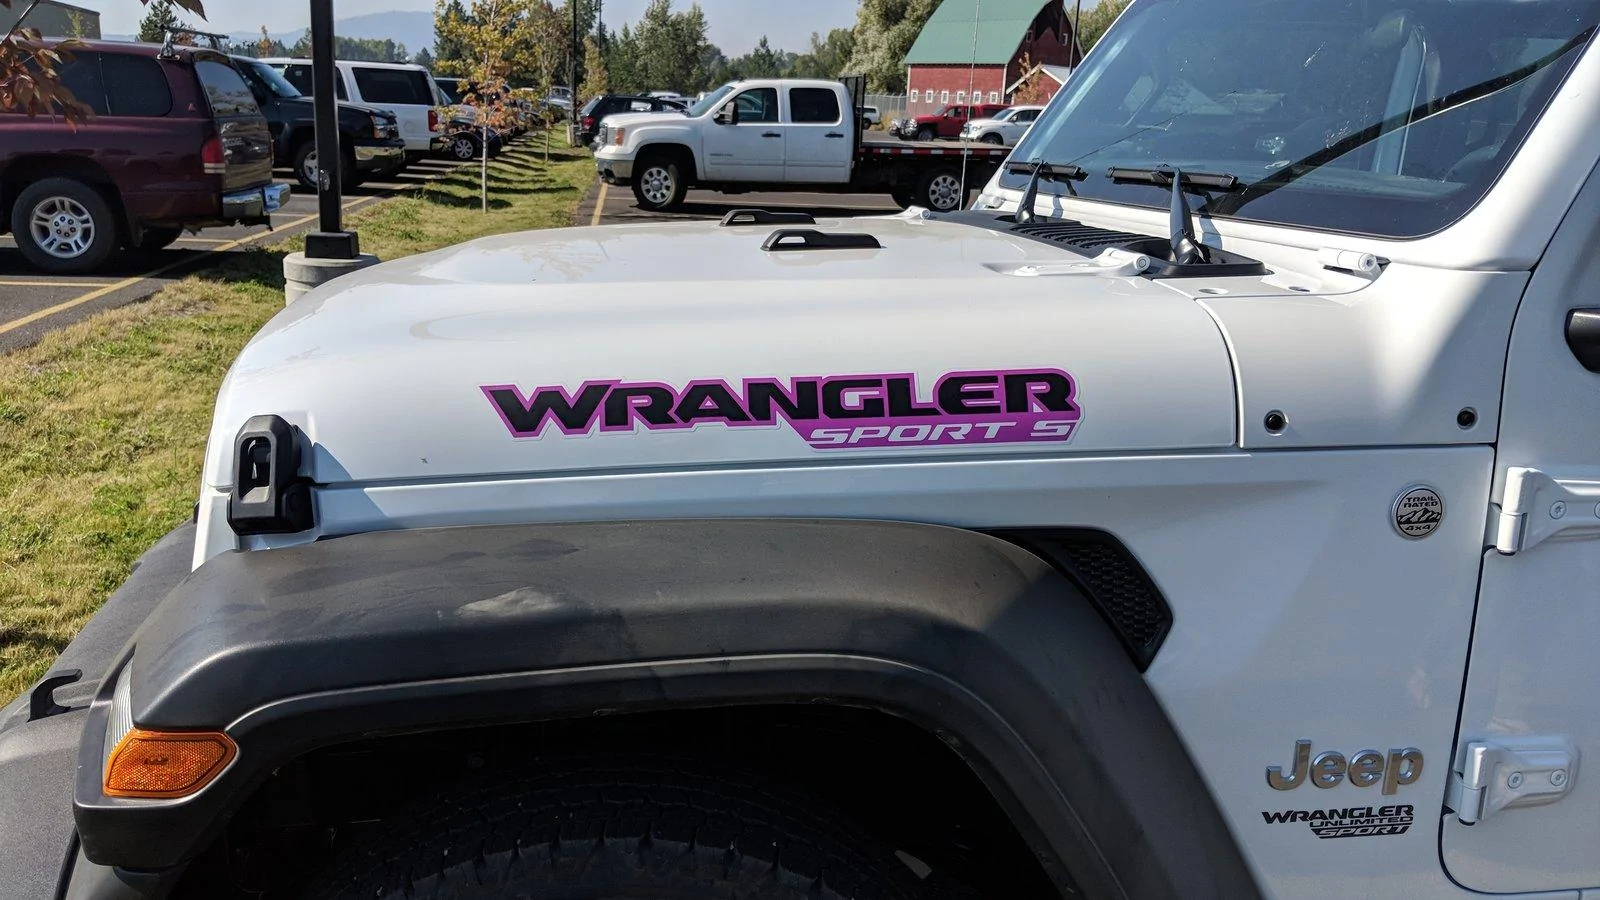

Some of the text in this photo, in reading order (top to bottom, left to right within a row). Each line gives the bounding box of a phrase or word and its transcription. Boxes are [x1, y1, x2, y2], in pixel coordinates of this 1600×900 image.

[482, 369, 1079, 436] WRANGLER
[806, 419, 1078, 445] SPORT S
[1265, 739, 1424, 796] Jeep
[1261, 804, 1414, 825] WRANGLER
[1309, 816, 1414, 828] UNLIMITED
[1314, 825, 1409, 838] SPORT
